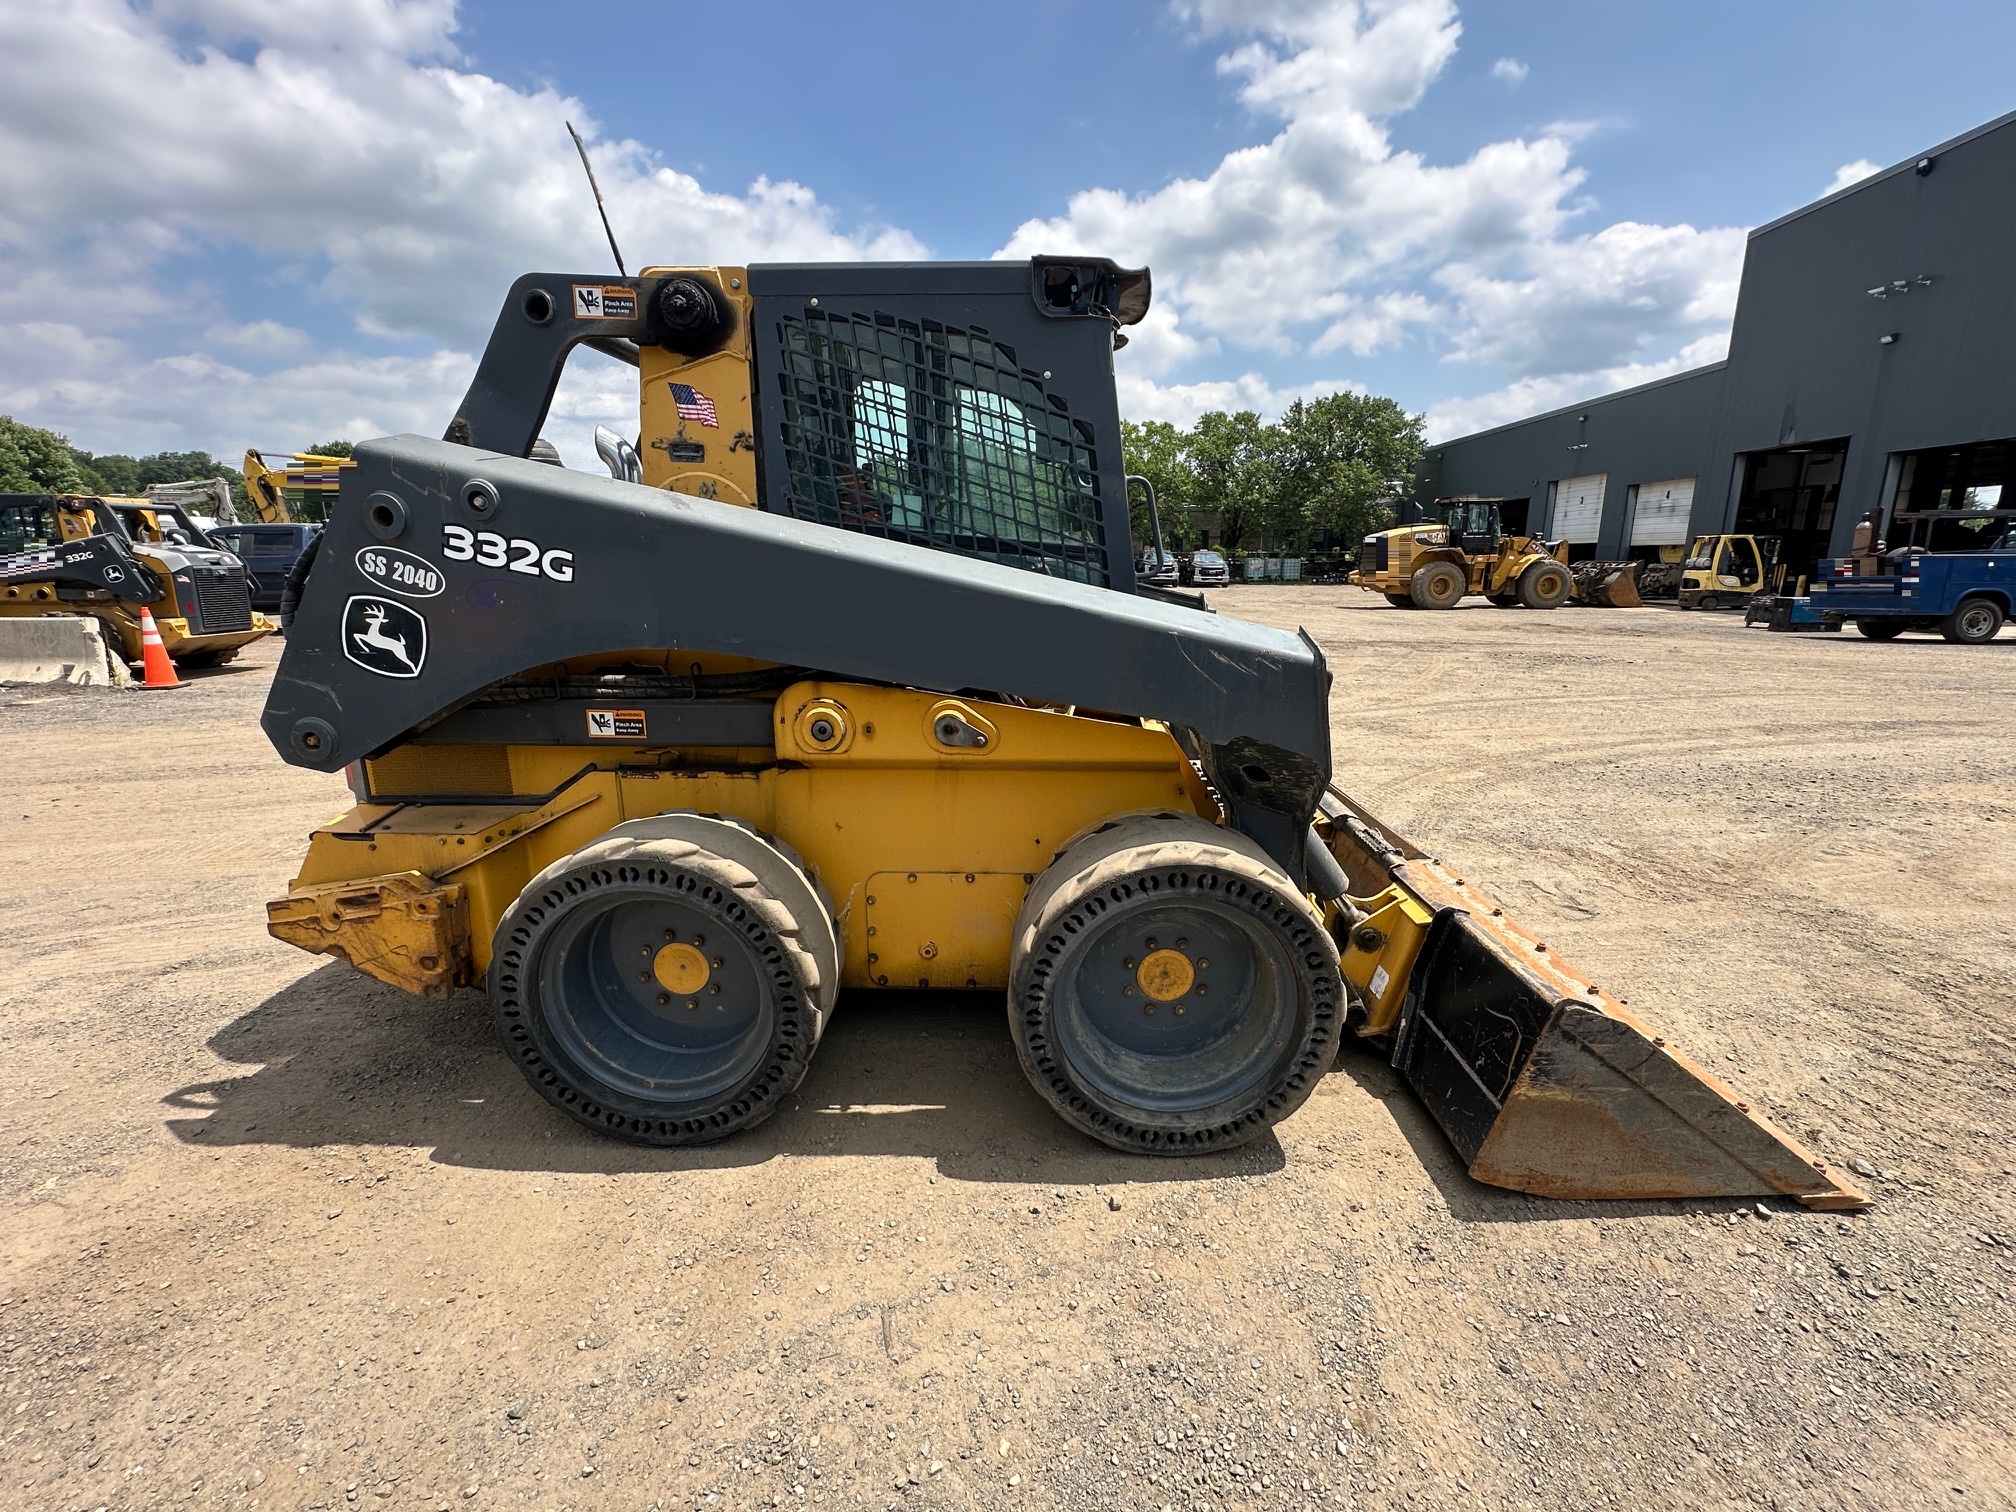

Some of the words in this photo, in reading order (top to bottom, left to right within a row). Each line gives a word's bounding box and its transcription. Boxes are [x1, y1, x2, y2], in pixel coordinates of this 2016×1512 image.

[65, 551, 94, 563] 332G
[364, 552, 387, 576] SS
[392, 561, 437, 592] 2040
[443, 525, 575, 583] 332G
